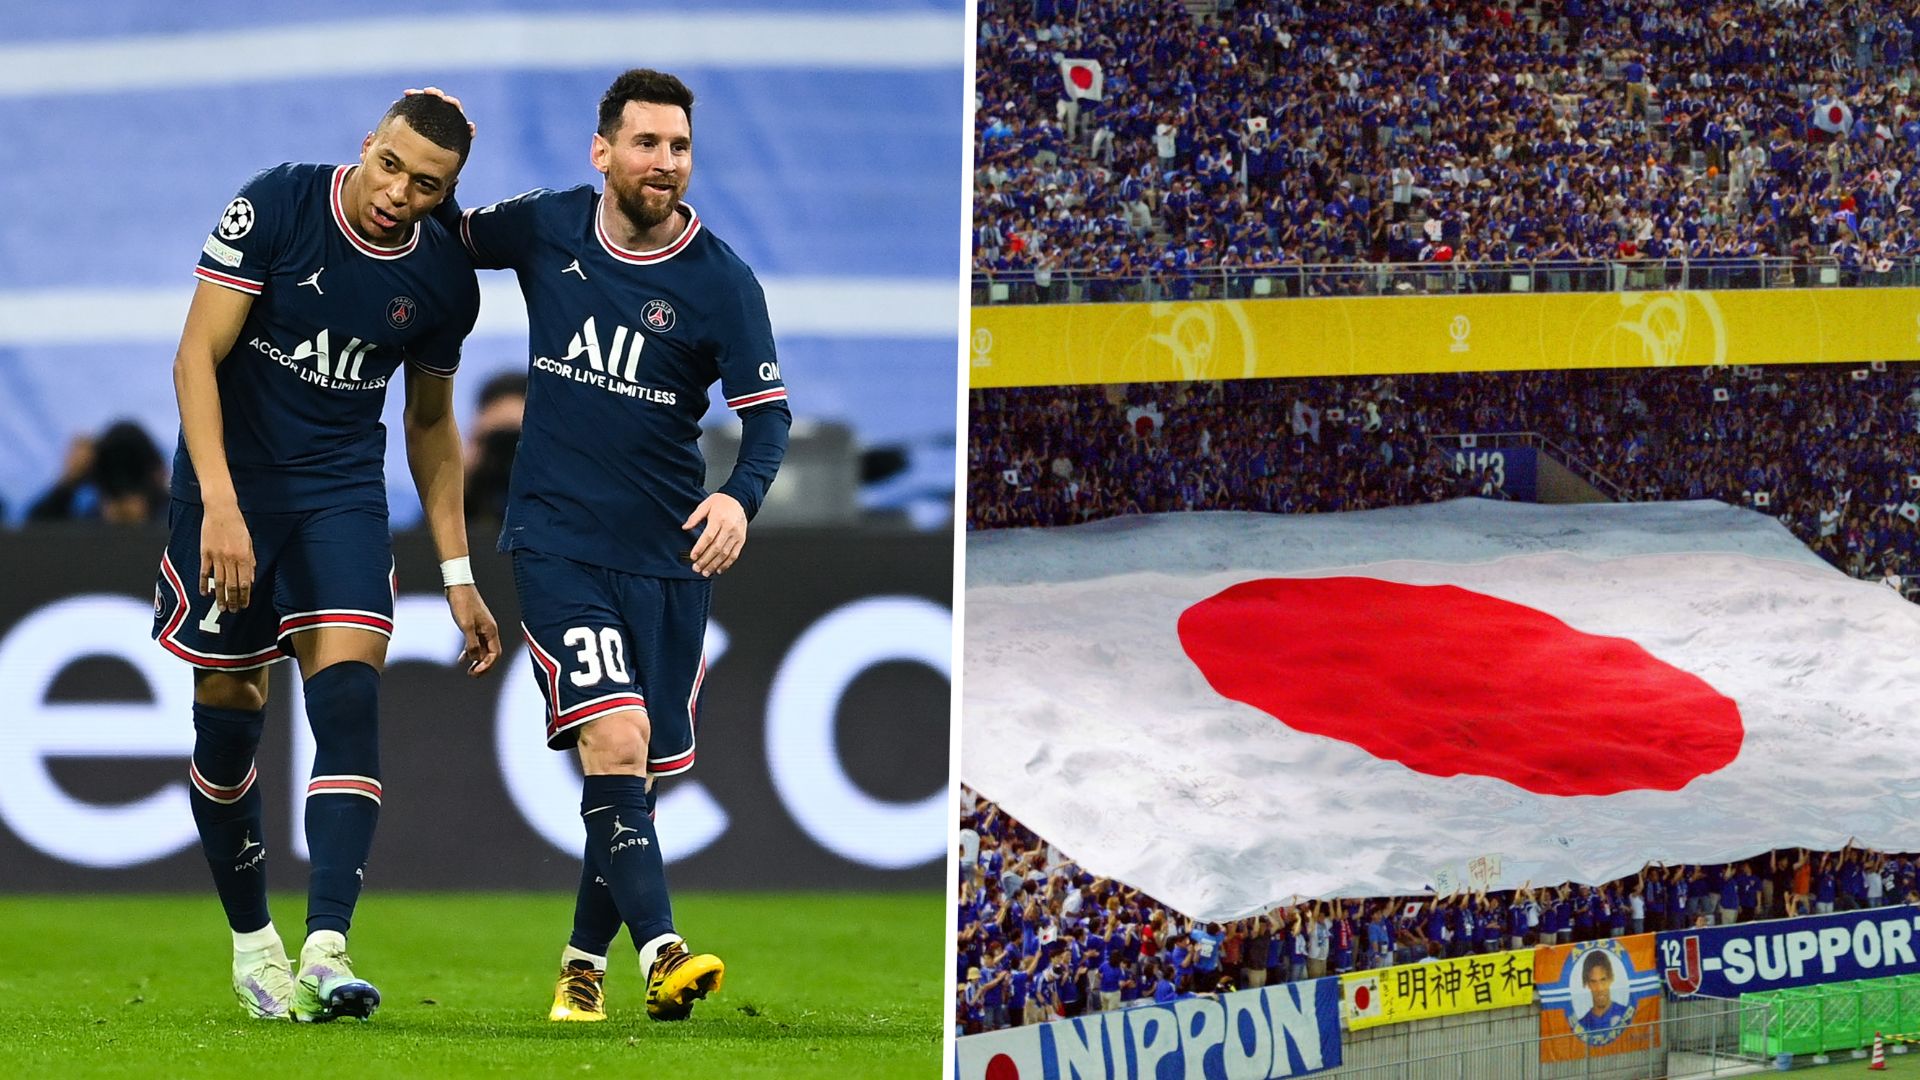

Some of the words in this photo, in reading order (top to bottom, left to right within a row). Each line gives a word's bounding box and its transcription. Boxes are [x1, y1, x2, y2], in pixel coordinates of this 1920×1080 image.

[249, 337, 299, 373] ACCOR
[300, 367, 330, 388] LIVE
[574, 368, 607, 388] LIVE
[607, 378, 677, 406] LIMITLESS
[563, 626, 631, 688] 30
[610, 837, 650, 856] PARIS
[1660, 938, 1682, 968] 12
[1664, 915, 1920, 997] J-SUPPOR
[1396, 954, 1534, 1011] 明神智和
[1051, 980, 1325, 1080] NIPPON
